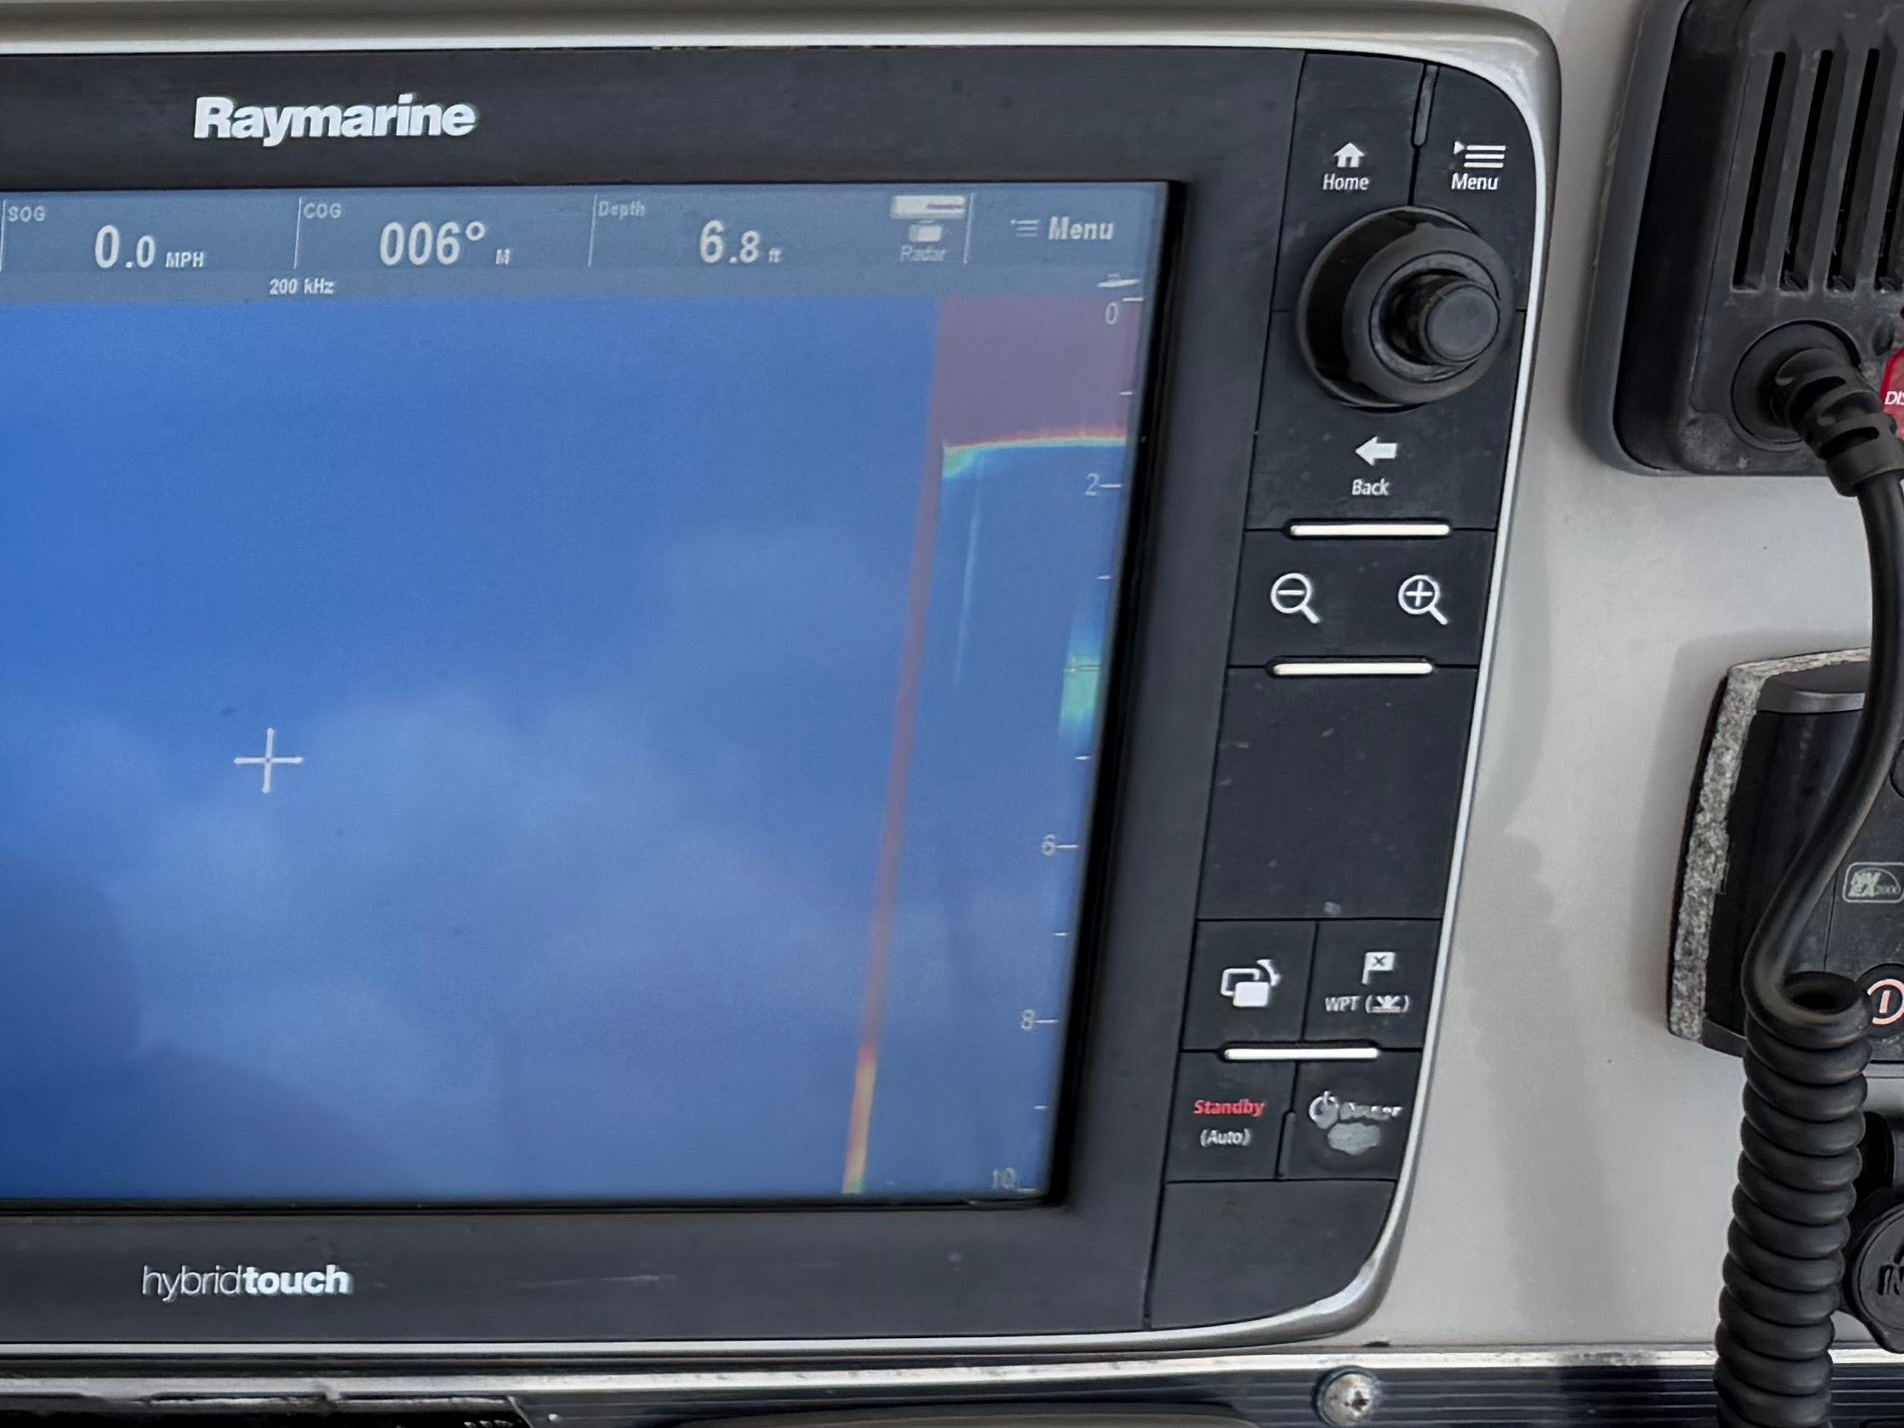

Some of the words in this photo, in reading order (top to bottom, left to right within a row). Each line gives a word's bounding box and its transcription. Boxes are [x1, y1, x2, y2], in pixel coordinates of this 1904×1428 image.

[193, 92, 478, 147] Raymarine
[1323, 174, 1370, 192] Home
[1451, 174, 1500, 192] Menu
[8, 206, 46, 223] SOG
[303, 202, 342, 220] COG
[598, 200, 647, 219] Depth
[1048, 216, 1114, 242] Menu
[94, 224, 156, 269] 0.0
[165, 251, 205, 269] MPH
[379, 220, 487, 266] 006°
[699, 220, 760, 264] 6.8
[899, 245, 948, 262] Radar
[269, 278, 298, 295] 200
[303, 278, 336, 295] kHz
[1352, 479, 1391, 496] Back
[1194, 1099, 1265, 1118] Standby
[1200, 1128, 1251, 1148] (Auto)
[141, 1264, 352, 1303] hybridtouch
